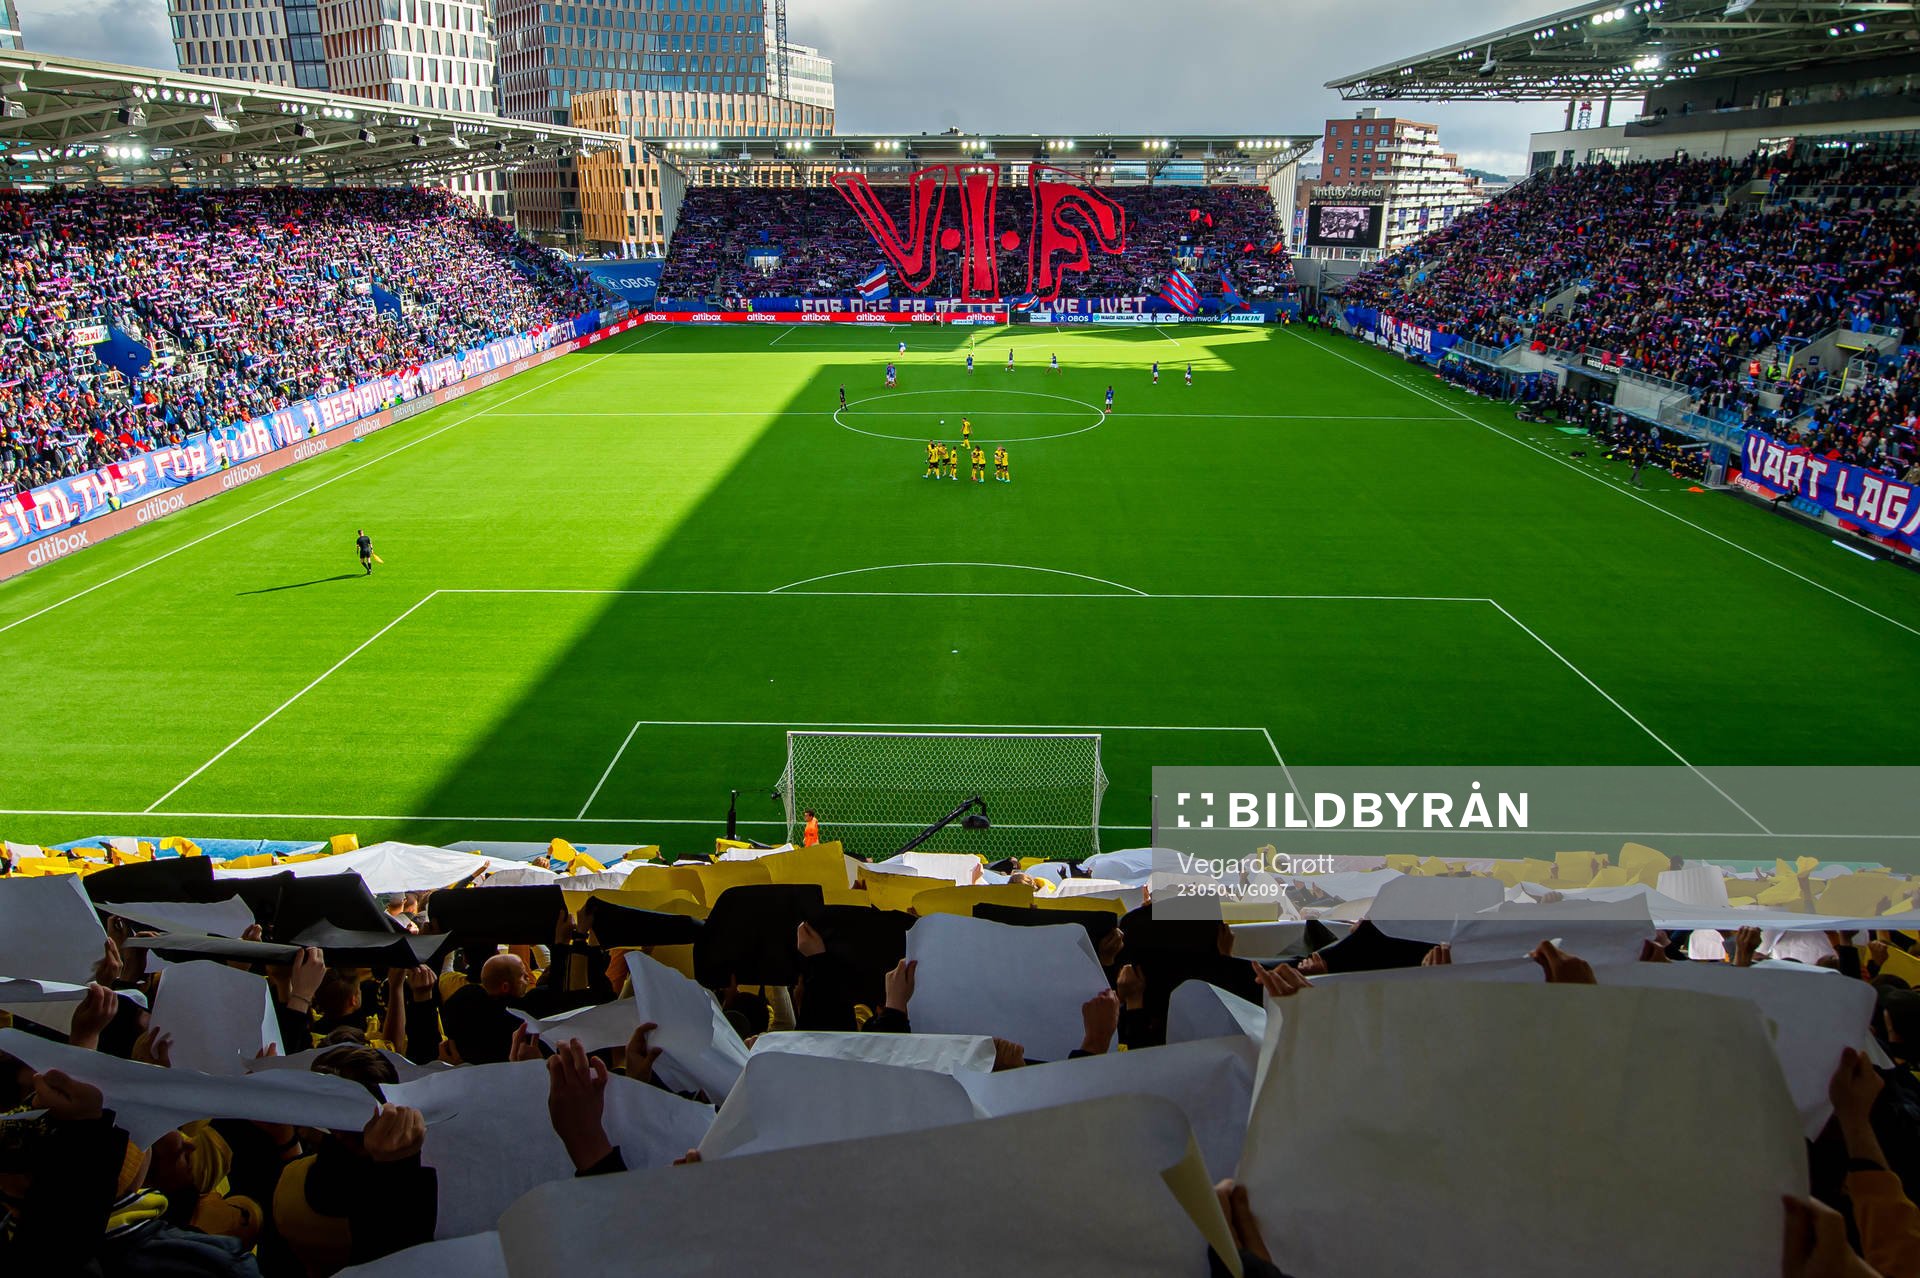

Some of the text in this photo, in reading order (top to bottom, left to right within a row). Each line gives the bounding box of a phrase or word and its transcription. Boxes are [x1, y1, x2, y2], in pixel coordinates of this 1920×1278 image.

[1350, 187, 1381, 197] arena
[620, 276, 657, 289] OBOS
[802, 299, 842, 312] FOR
[899, 299, 926, 312] ER
[692, 312, 722, 321] altibox
[746, 312, 776, 321] altibox
[801, 312, 831, 321] altibox
[856, 312, 886, 321] altibox
[966, 312, 995, 321] altibox
[444, 384, 466, 401] altibox
[353, 415, 382, 438] altibox
[293, 437, 329, 461] altibox
[222, 462, 264, 489] altibox
[136, 492, 186, 523] altibox
[1834, 470, 1920, 536] LAG
[27, 529, 89, 566] altibox
